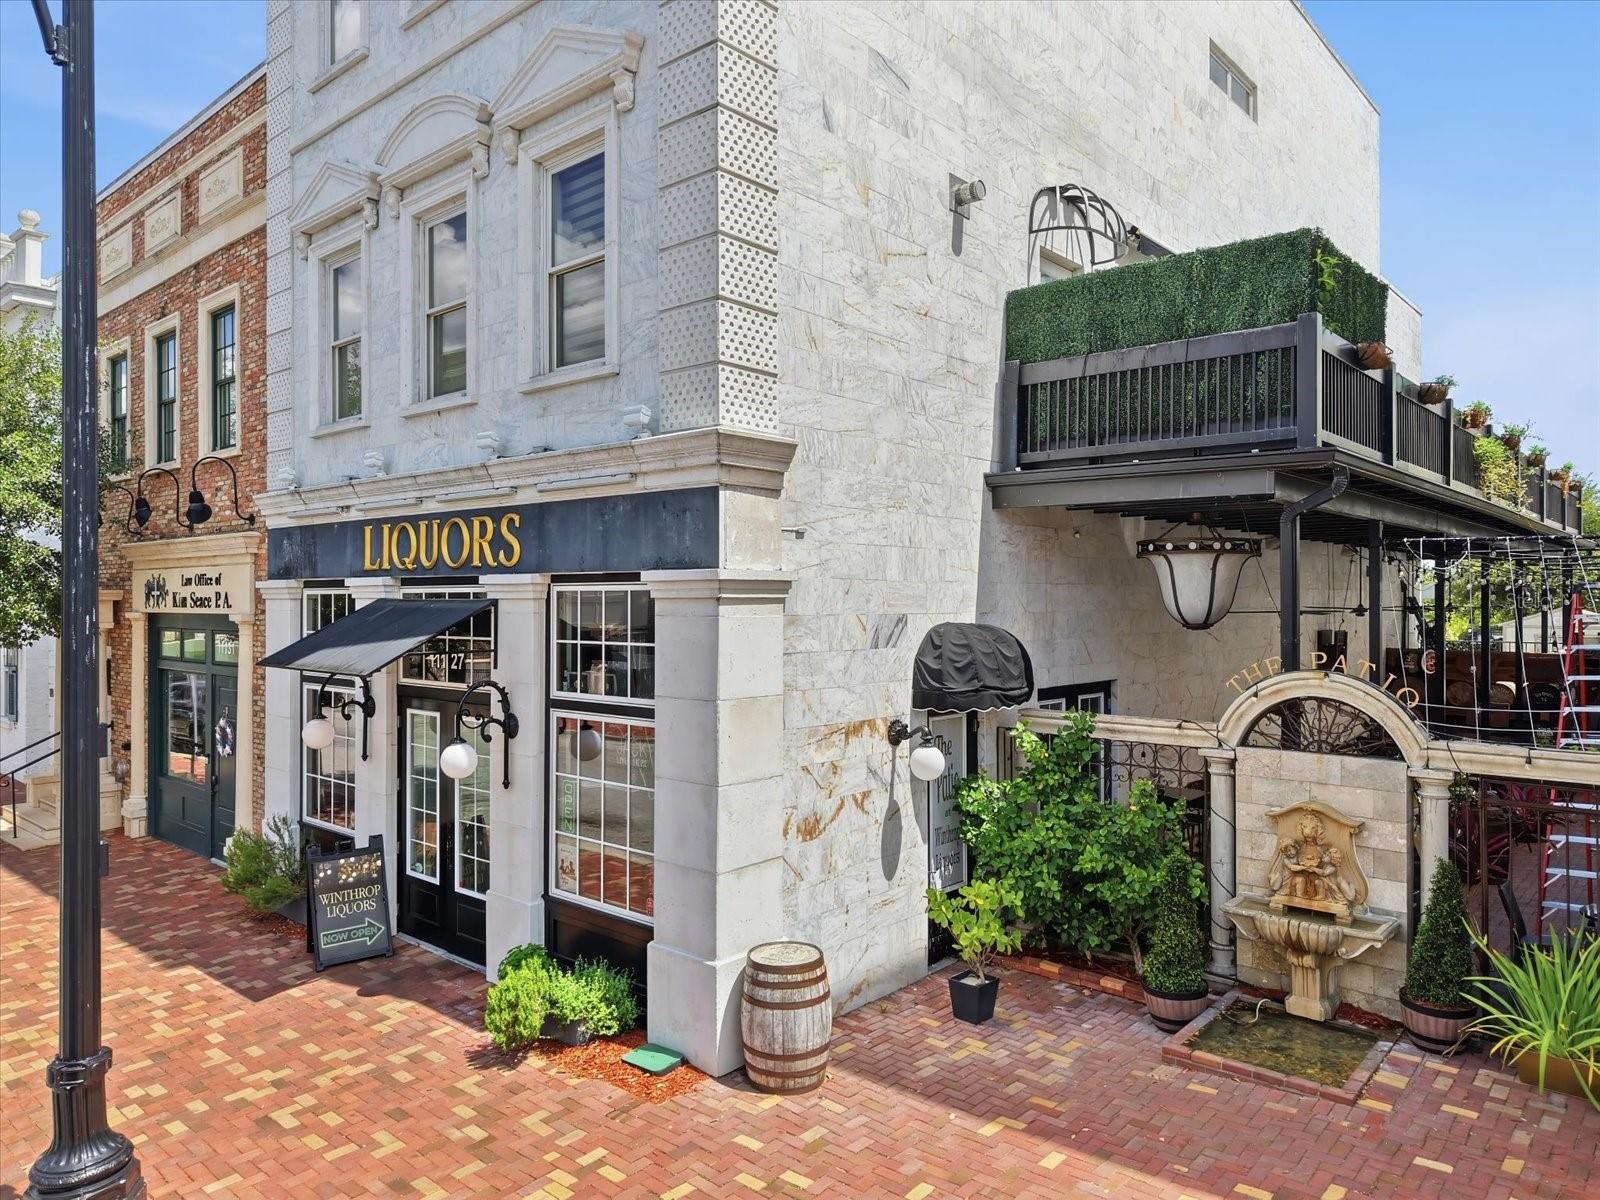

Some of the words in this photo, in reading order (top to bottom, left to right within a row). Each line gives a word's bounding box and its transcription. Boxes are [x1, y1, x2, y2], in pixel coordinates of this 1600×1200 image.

[363, 512, 521, 571] LIQUORS
[181, 574, 193, 587] Law
[194, 573, 214, 587] Office
[214, 572, 222, 586] of
[172, 591, 188, 608] Kim
[1225, 656, 1283, 694] THE
[1308, 651, 1420, 709] PATIO
[933, 734, 953, 756] The
[563, 783, 573, 831] OPEN
[319, 884, 381, 905] WINTHROP
[327, 898, 376, 918] LIQUORS
[323, 932, 349, 945] NOW
[350, 925, 378, 939] OPEN
